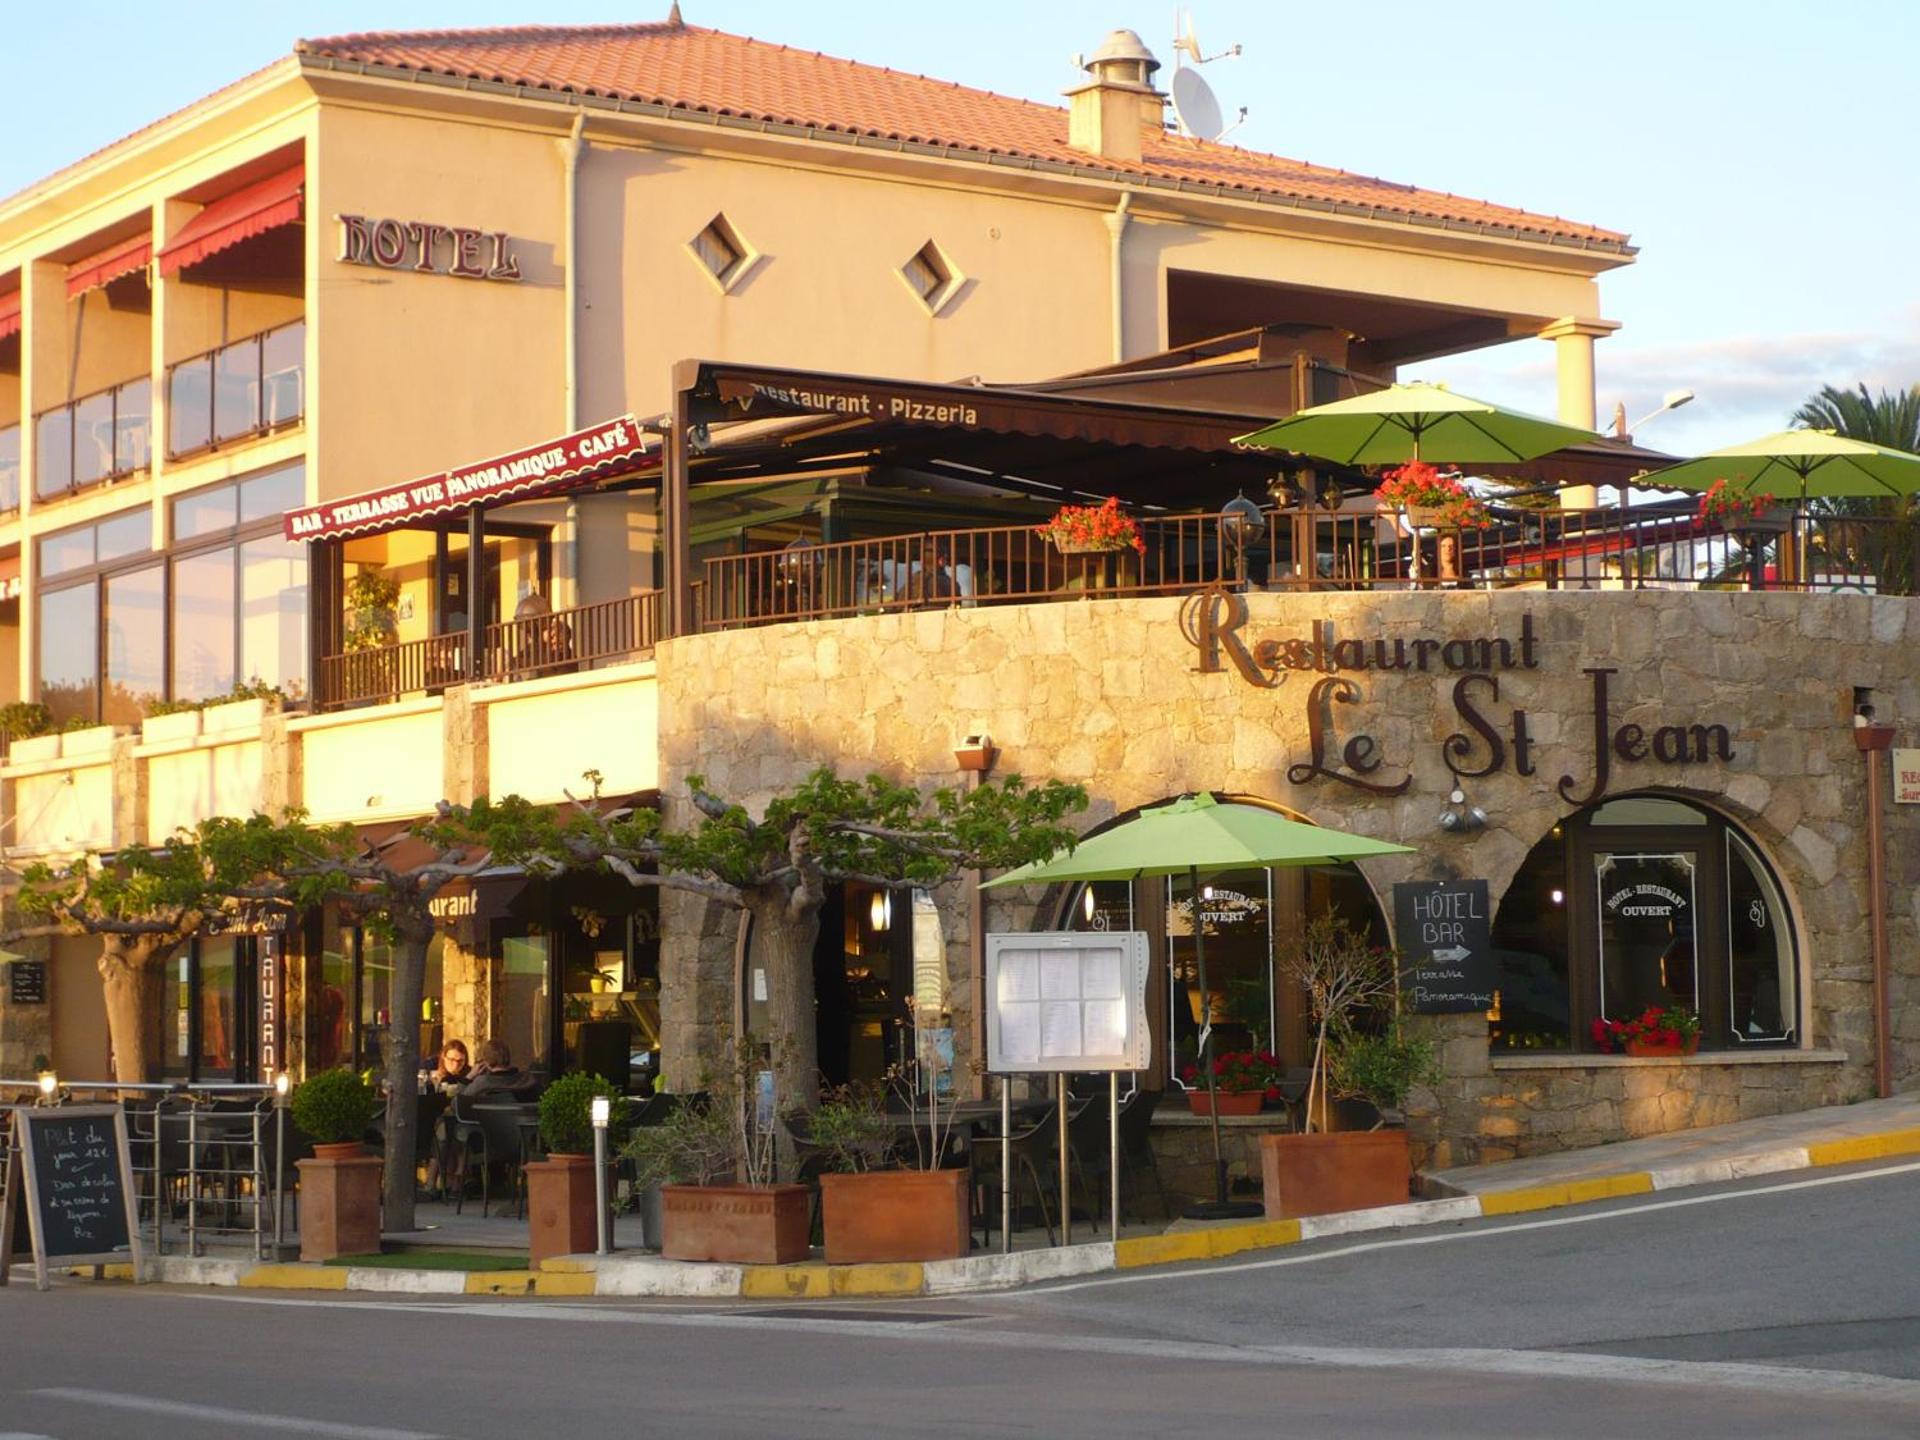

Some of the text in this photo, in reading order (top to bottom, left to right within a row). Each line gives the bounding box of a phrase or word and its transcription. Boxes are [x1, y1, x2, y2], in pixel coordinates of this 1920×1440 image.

[334, 214, 521, 281] HOTEL
[890, 398, 977, 425] Pizzeria
[292, 424, 630, 535] BAR TERRASSE VUE PANORAMIQUE CAFÉ
[1179, 584, 1538, 688] Restaurant
[1287, 668, 1736, 806] Le St Jean
[1413, 890, 1484, 920] HÔTEL
[1622, 906, 1673, 916] OUVERT
[1423, 922, 1465, 943] BAR
[1414, 986, 1495, 1008] Panoramique
